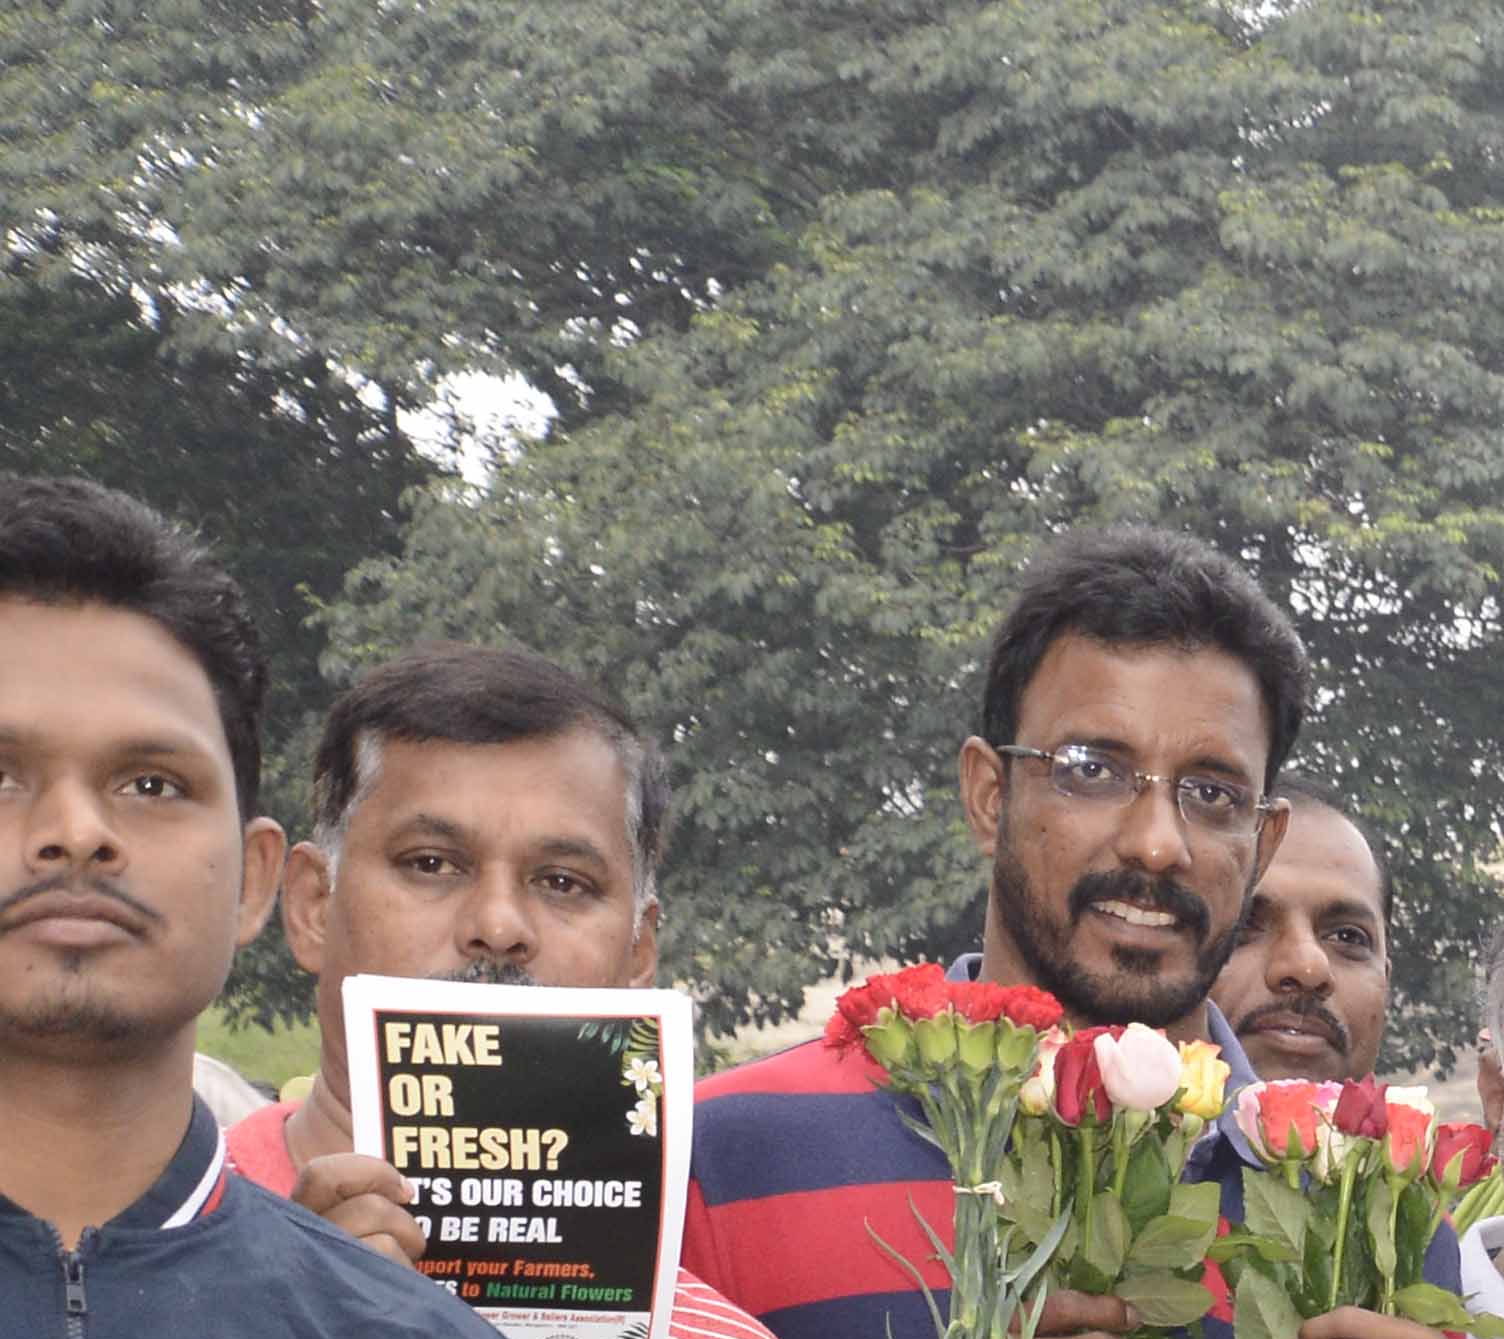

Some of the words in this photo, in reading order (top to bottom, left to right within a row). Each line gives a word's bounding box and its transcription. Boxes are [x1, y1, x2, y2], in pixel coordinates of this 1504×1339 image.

[384, 1021, 503, 1067] FAKE
[389, 1073, 455, 1118] OR
[392, 1126, 570, 1171] FRESH?
[409, 1176, 453, 1206] T'S
[460, 1177, 524, 1207] OUR
[531, 1179, 643, 1208] CHOICE
[440, 1216, 481, 1242] BE
[487, 1216, 563, 1243] REAL
[466, 1261, 509, 1277] your
[461, 1282, 481, 1298] to
[486, 1282, 556, 1300] Natural
[560, 1284, 633, 1302] Flowers
